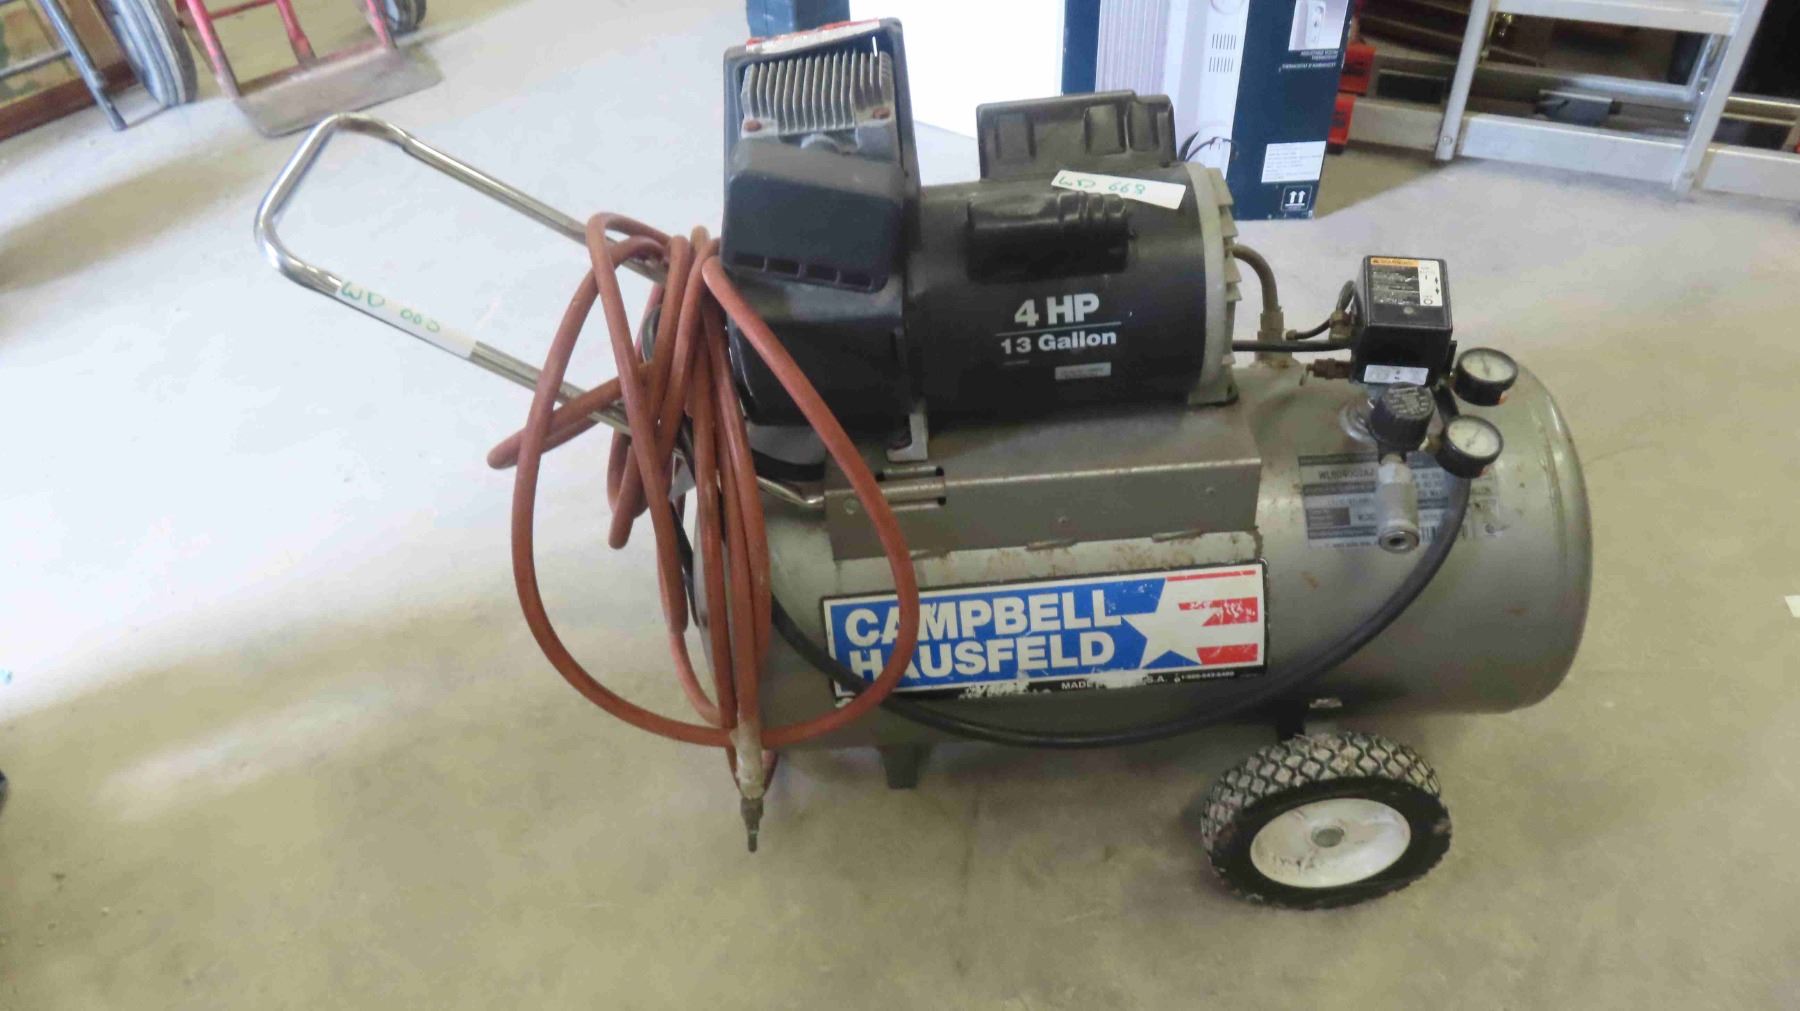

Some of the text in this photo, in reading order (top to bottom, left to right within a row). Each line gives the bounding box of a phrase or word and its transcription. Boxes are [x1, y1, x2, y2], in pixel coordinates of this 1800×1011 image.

[1014, 292, 1100, 327] 4 HP
[1001, 329, 1117, 354] 13 Gallon
[849, 632, 1116, 681] HUSFELD
